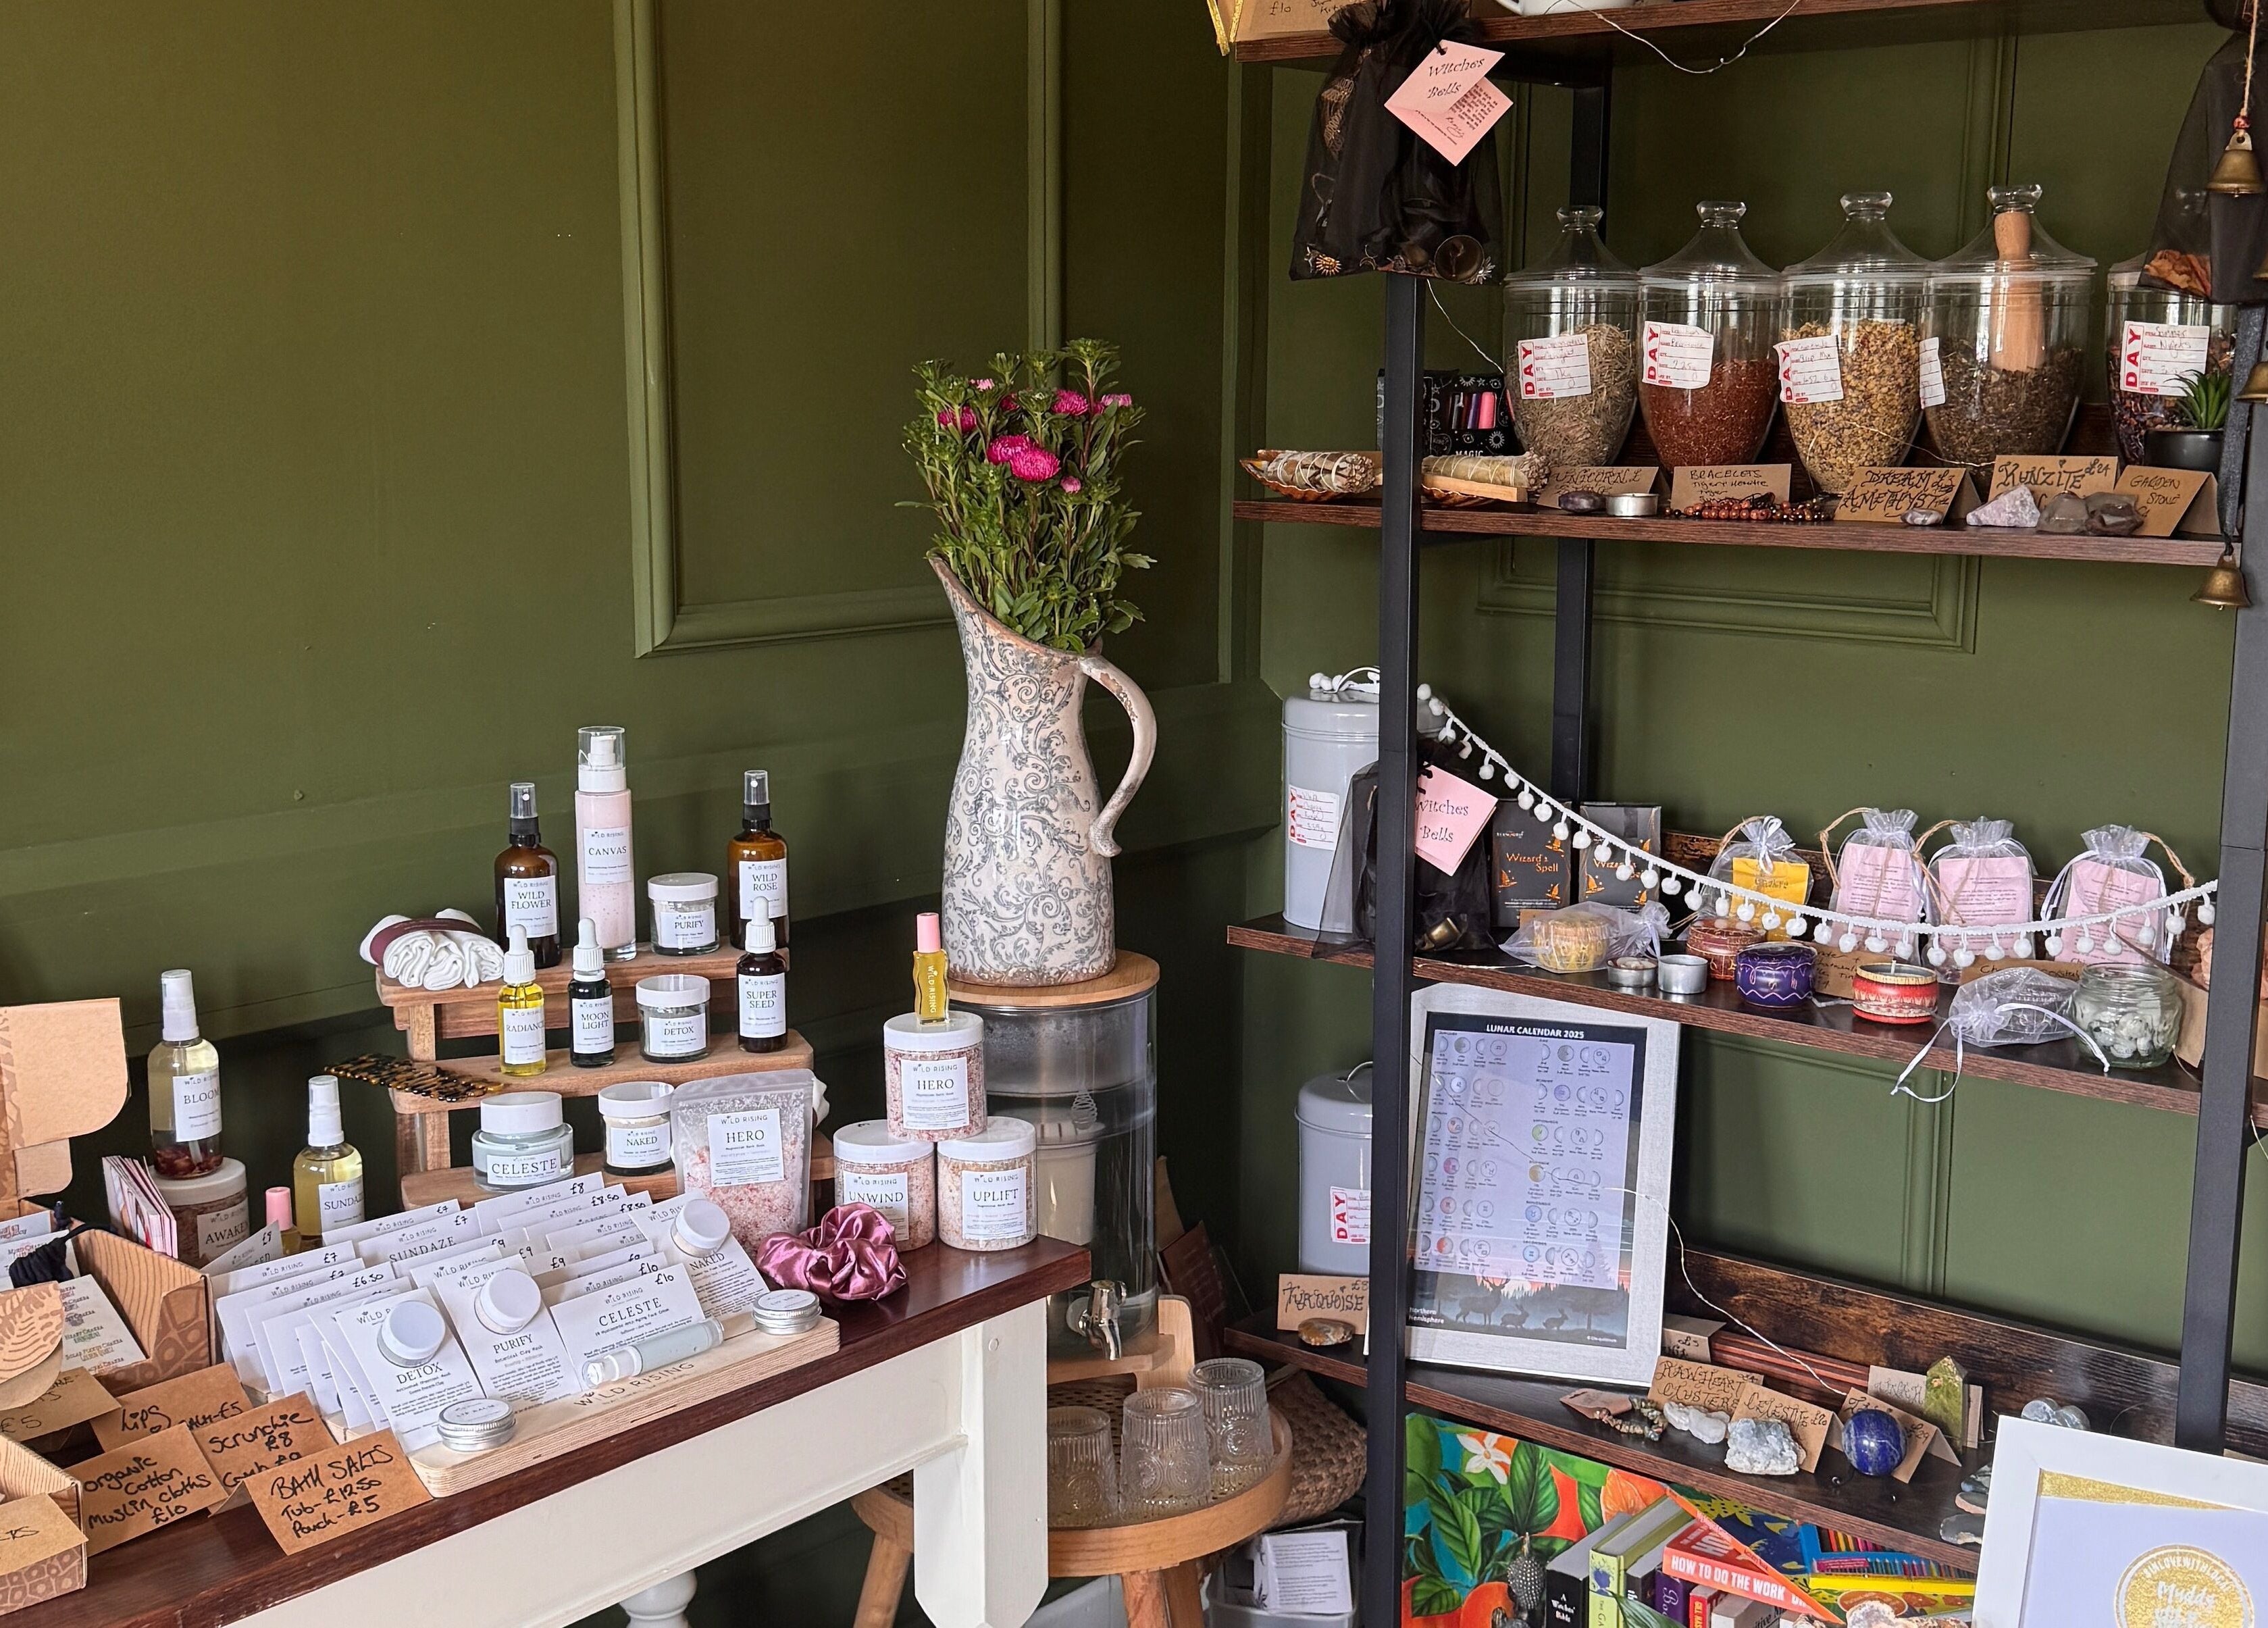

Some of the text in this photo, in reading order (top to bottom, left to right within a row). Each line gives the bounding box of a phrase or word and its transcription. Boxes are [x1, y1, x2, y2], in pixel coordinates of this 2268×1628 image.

[1270, 3, 1291, 16] £10
[1428, 58, 1485, 77] Witches
[1427, 82, 1462, 99] Bells
[1647, 328, 1659, 380] DAY
[2125, 328, 2141, 388] DAY
[1521, 346, 1535, 395] DAY
[1781, 348, 1793, 401] DAY
[1420, 825, 1453, 842] Bells
[588, 846, 627, 856] CANVAS
[1535, 863, 1559, 874] Spell
[752, 873, 778, 882] WILD
[753, 882, 778, 891] ROSE
[518, 890, 545, 900] WILD
[511, 899, 552, 909] FLOWER
[674, 920, 704, 930] PURIFY
[746, 990, 777, 999] SUPER
[749, 1000, 775, 1009] SEED
[581, 1011, 609, 1021] MOON
[582, 1020, 609, 1029] LIGHT
[663, 1025, 695, 1036] DETOX
[1486, 1023, 1585, 1040] LUNAR CALENDAR 2025
[917, 1078, 955, 1090] HERO
[626, 1136, 659, 1146] NAKED
[726, 1129, 765, 1144] HERO
[491, 1158, 558, 1175] CELESTE
[570, 1182, 585, 1195] £8
[973, 1188, 1019, 1202] UPLIFT
[590, 1194, 620, 1207] £8.50
[849, 1191, 904, 1203] UNWIND
[454, 1215, 468, 1226] £7
[1334, 1194, 1349, 1240] DAY
[389, 1236, 457, 1263] SUNDAZE
[324, 1252, 338, 1263] £7
[550, 1256, 567, 1270] £9
[689, 1252, 725, 1271] NAKED
[638, 1262, 659, 1276] £10
[352, 1273, 384, 1288] £6.50
[654, 1273, 675, 1285] £10
[598, 1296, 663, 1327] CELESTE
[492, 1333, 534, 1354] PURIFY
[396, 1360, 444, 1385] DETOX
[629, 1360, 695, 1388] RISING
[265, 1431, 293, 1452] £8
[271, 1444, 394, 1500] BATH SALTS
[151, 1504, 188, 1525] £10
[1671, 1554, 1786, 1601] HOW TO DO THE WORK
